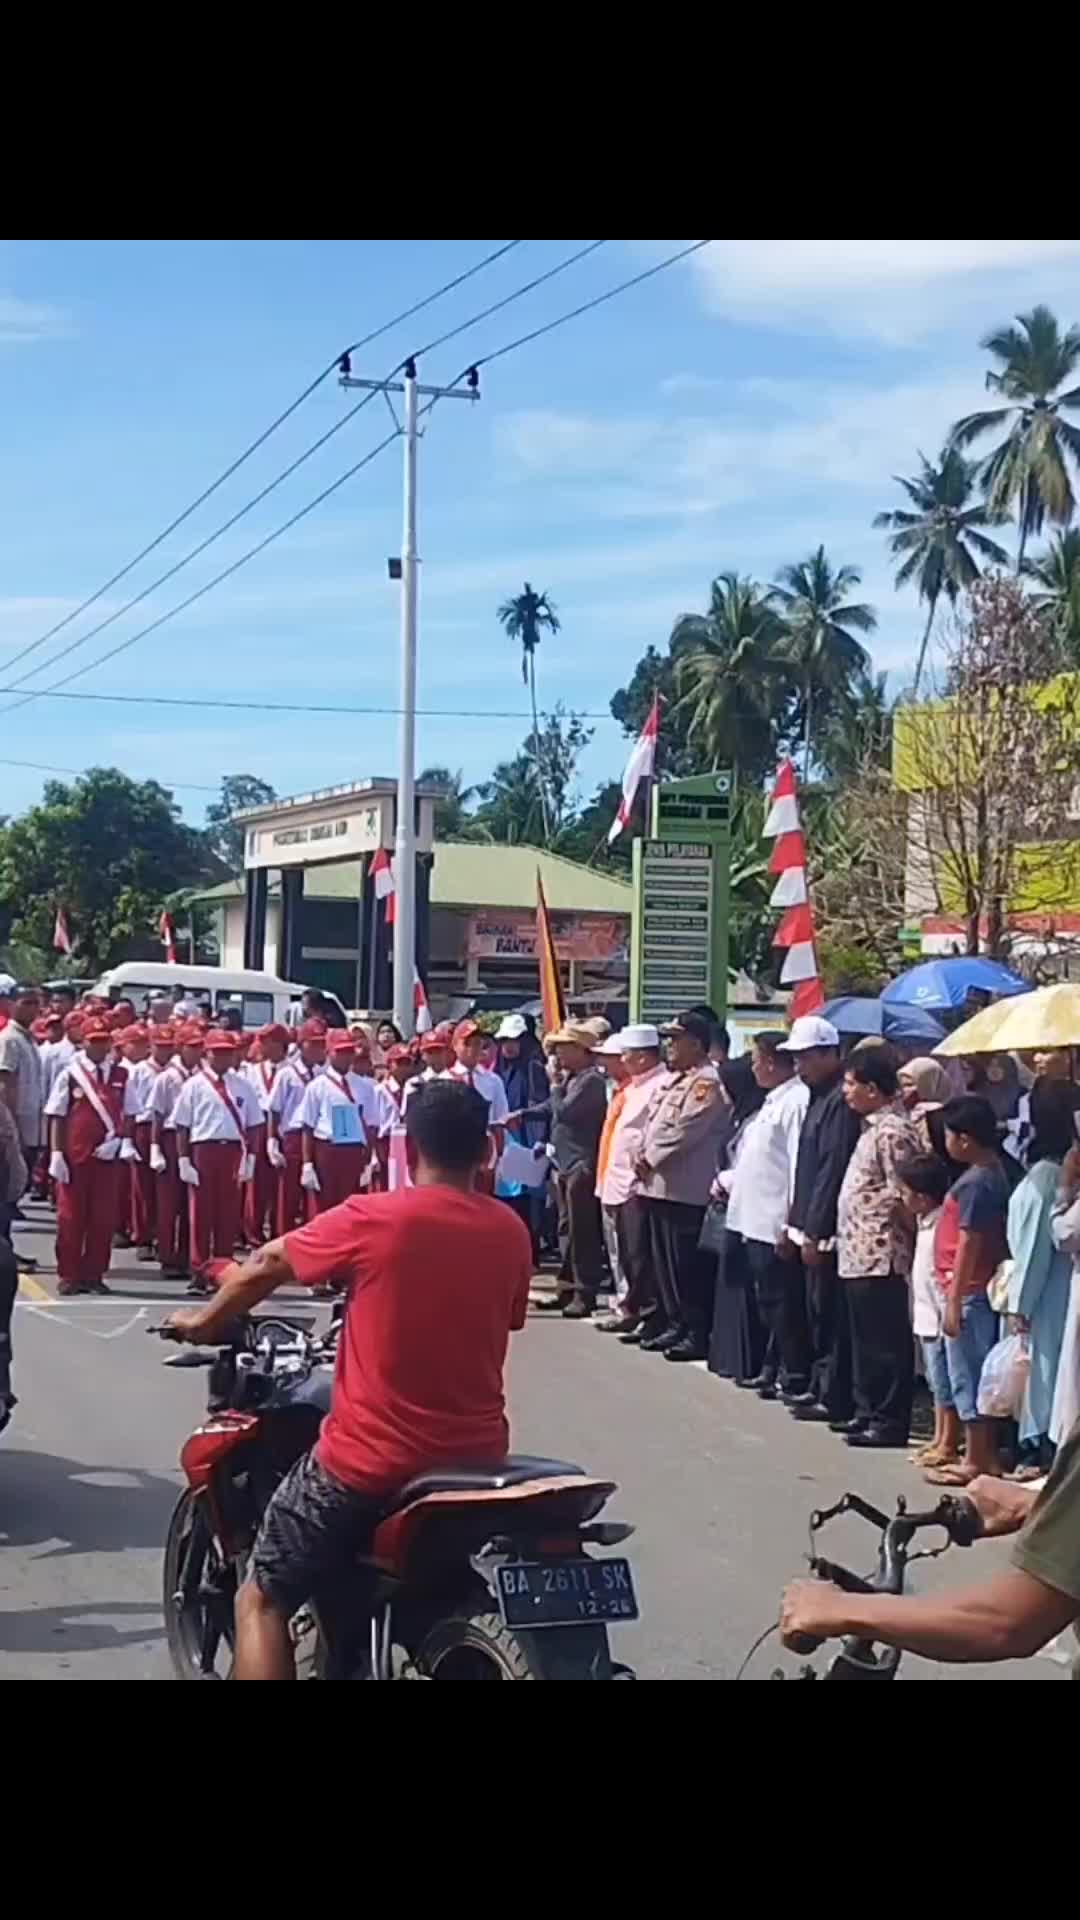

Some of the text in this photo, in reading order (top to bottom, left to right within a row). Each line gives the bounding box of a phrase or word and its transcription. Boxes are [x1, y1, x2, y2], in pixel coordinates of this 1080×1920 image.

[502, 1565, 628, 1594] BA 2611 SK
